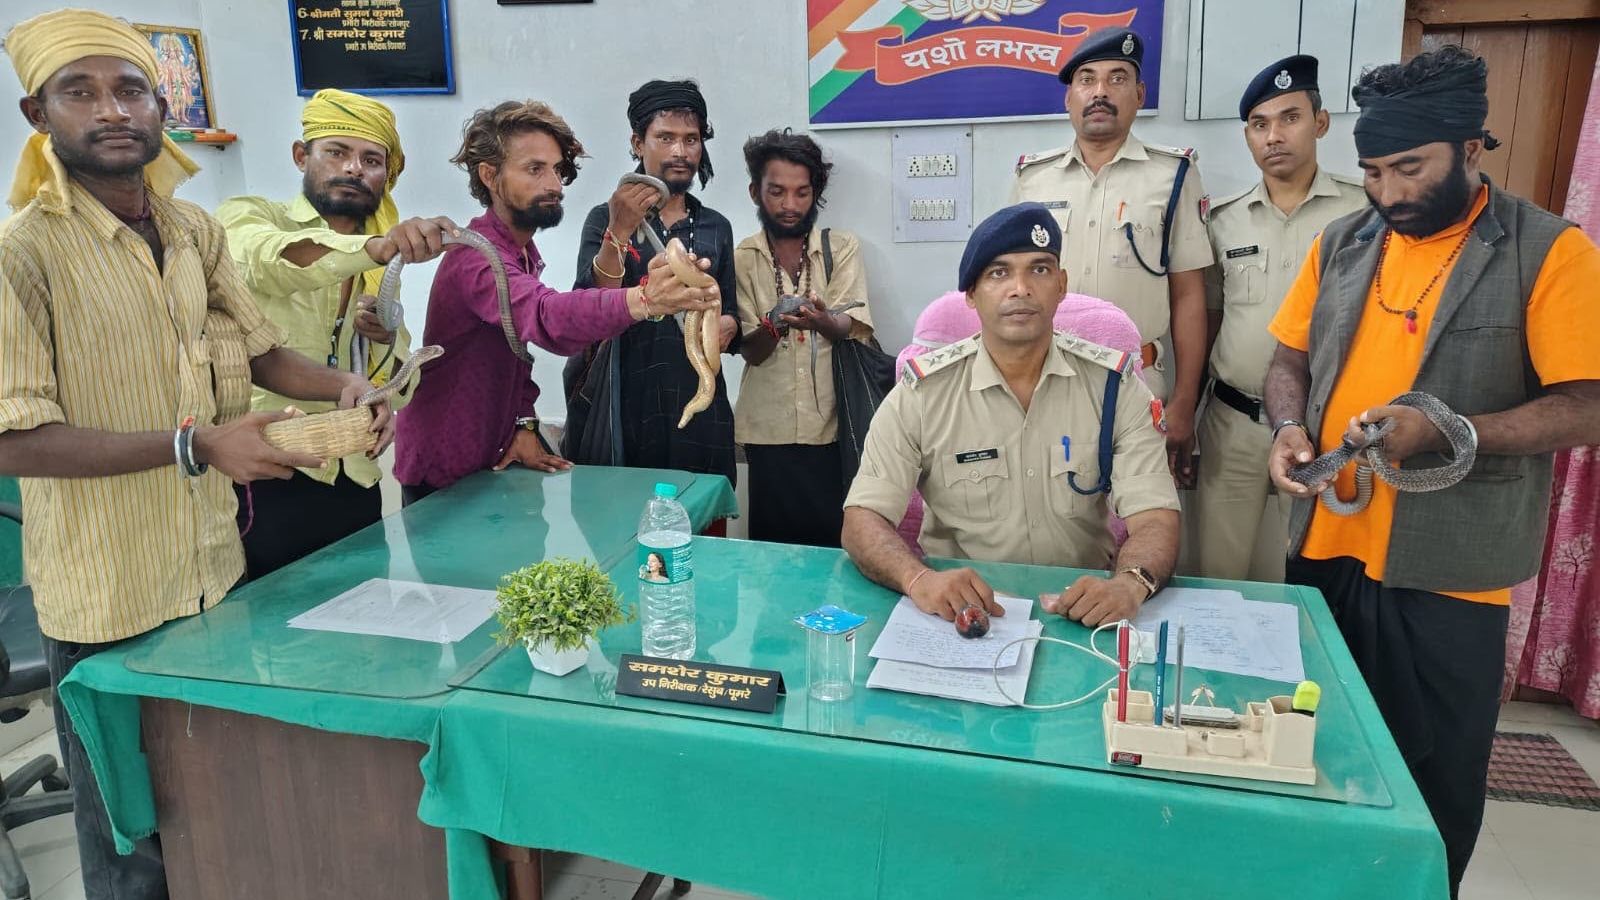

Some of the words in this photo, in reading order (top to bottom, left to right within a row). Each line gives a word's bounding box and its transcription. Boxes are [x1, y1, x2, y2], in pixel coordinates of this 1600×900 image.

[344, 9, 370, 20] सुमन
[372, 8, 403, 20] कुमारी
[313, 27, 325, 41] श्री
[326, 27, 367, 38] समशेर
[369, 29, 405, 41] कुमार
[901, 37, 968, 70] यशो
[975, 39, 1062, 67] लभस्व
[628, 661, 702, 678] समशेर
[706, 670, 772, 687] कुमार
[641, 678, 656, 688] उप
